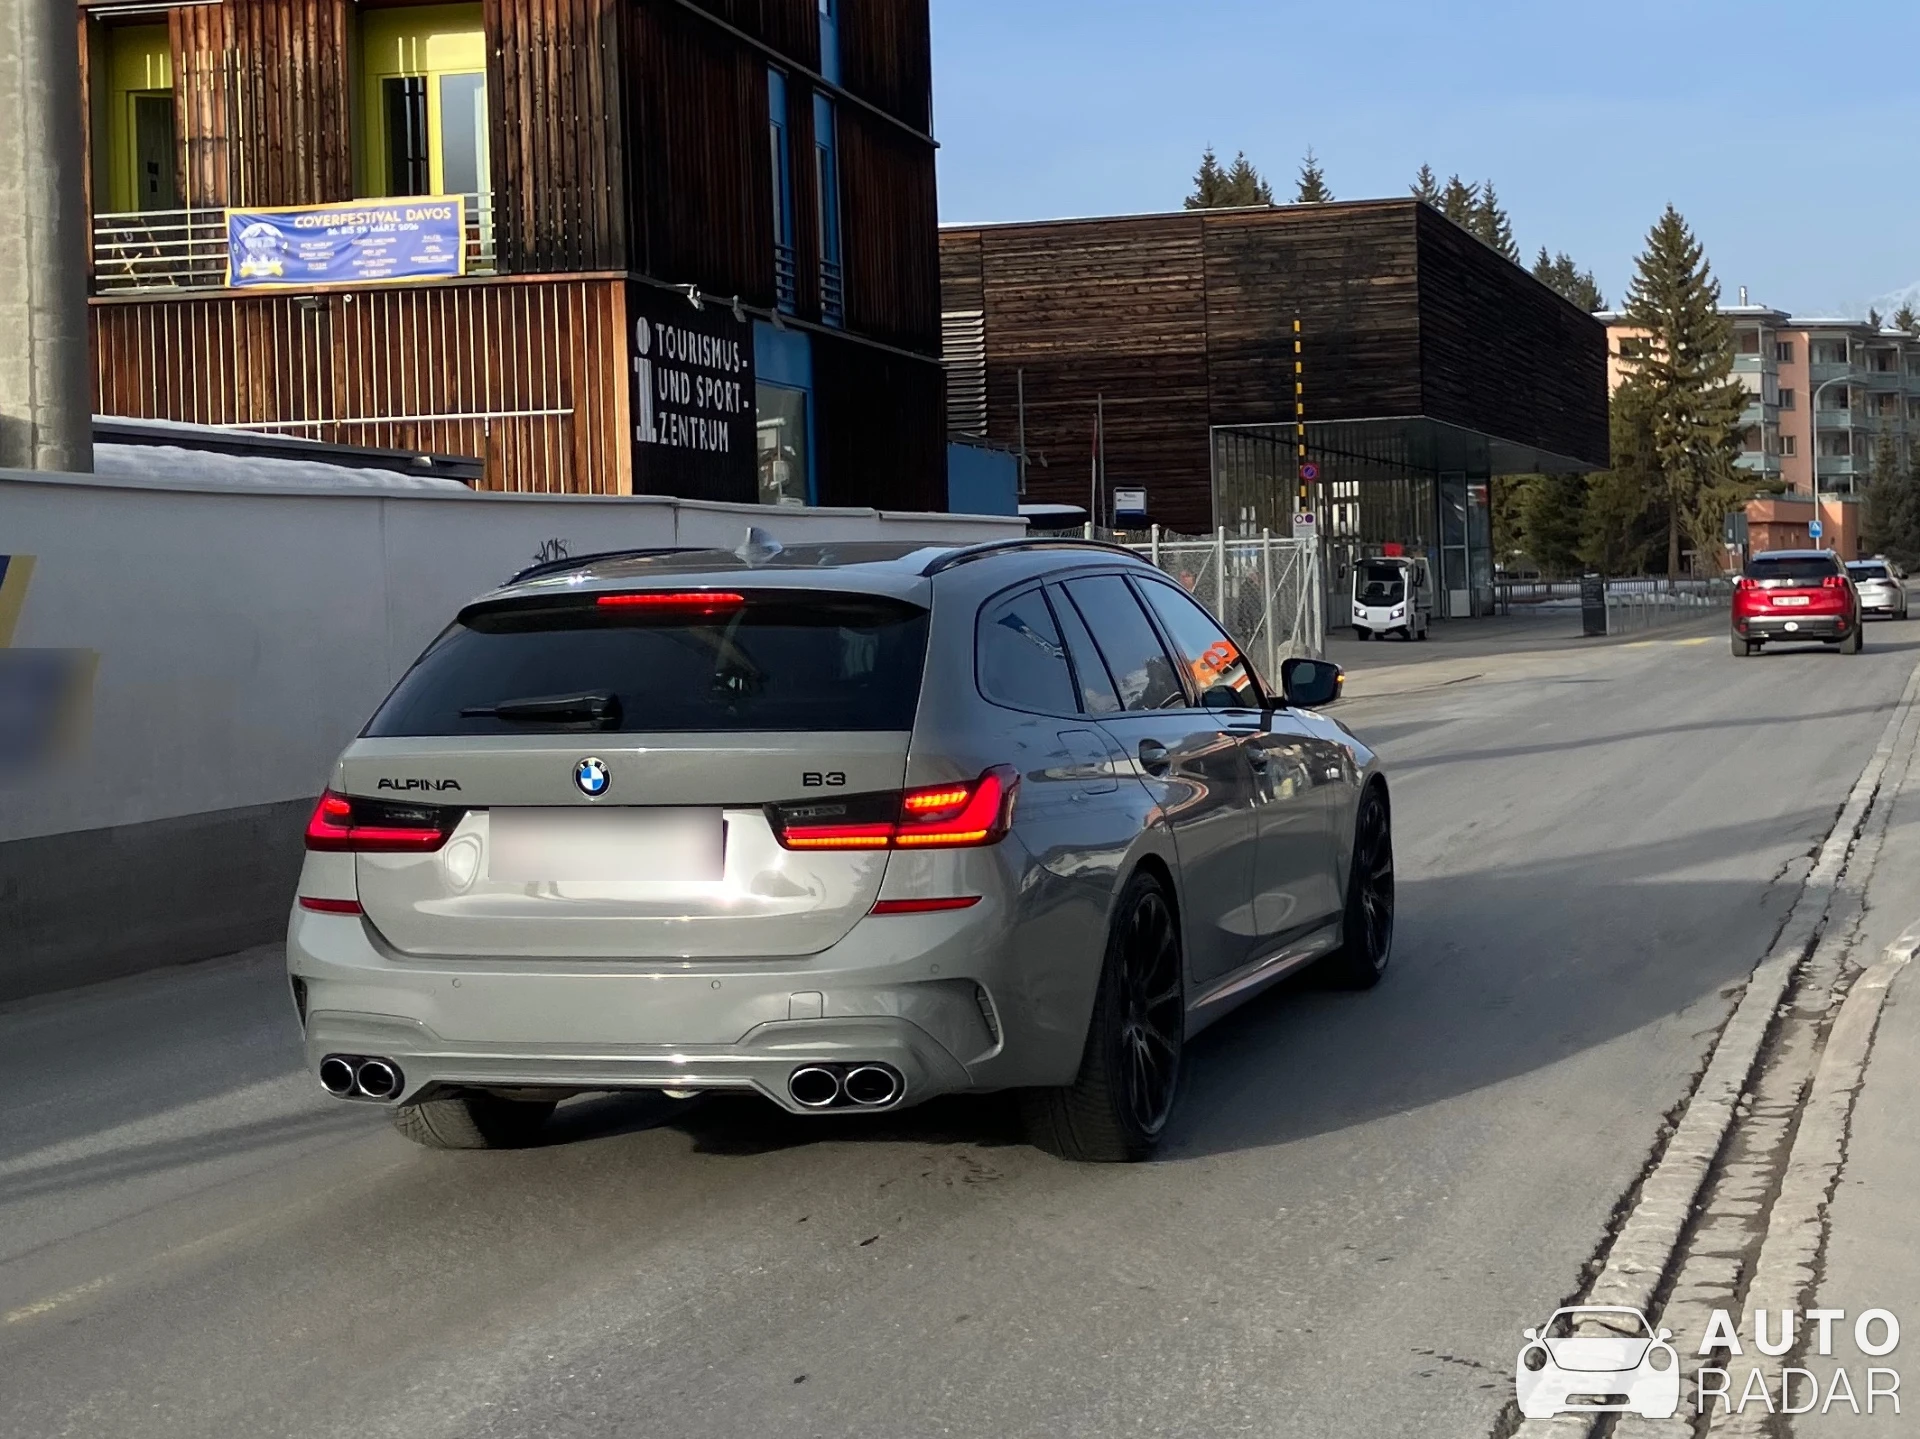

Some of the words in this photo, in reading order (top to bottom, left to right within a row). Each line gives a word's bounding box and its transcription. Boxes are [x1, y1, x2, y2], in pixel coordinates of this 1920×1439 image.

[294, 210, 401, 228] COVERFESTIVAL
[406, 207, 452, 221] DAVOS
[655, 322, 748, 373] TOURISMUS-
[658, 366, 690, 405] UND
[696, 375, 749, 413] SPORT-
[658, 411, 729, 452] ZENTRUM
[377, 778, 463, 791] ALPINA
[802, 771, 846, 786] B3
